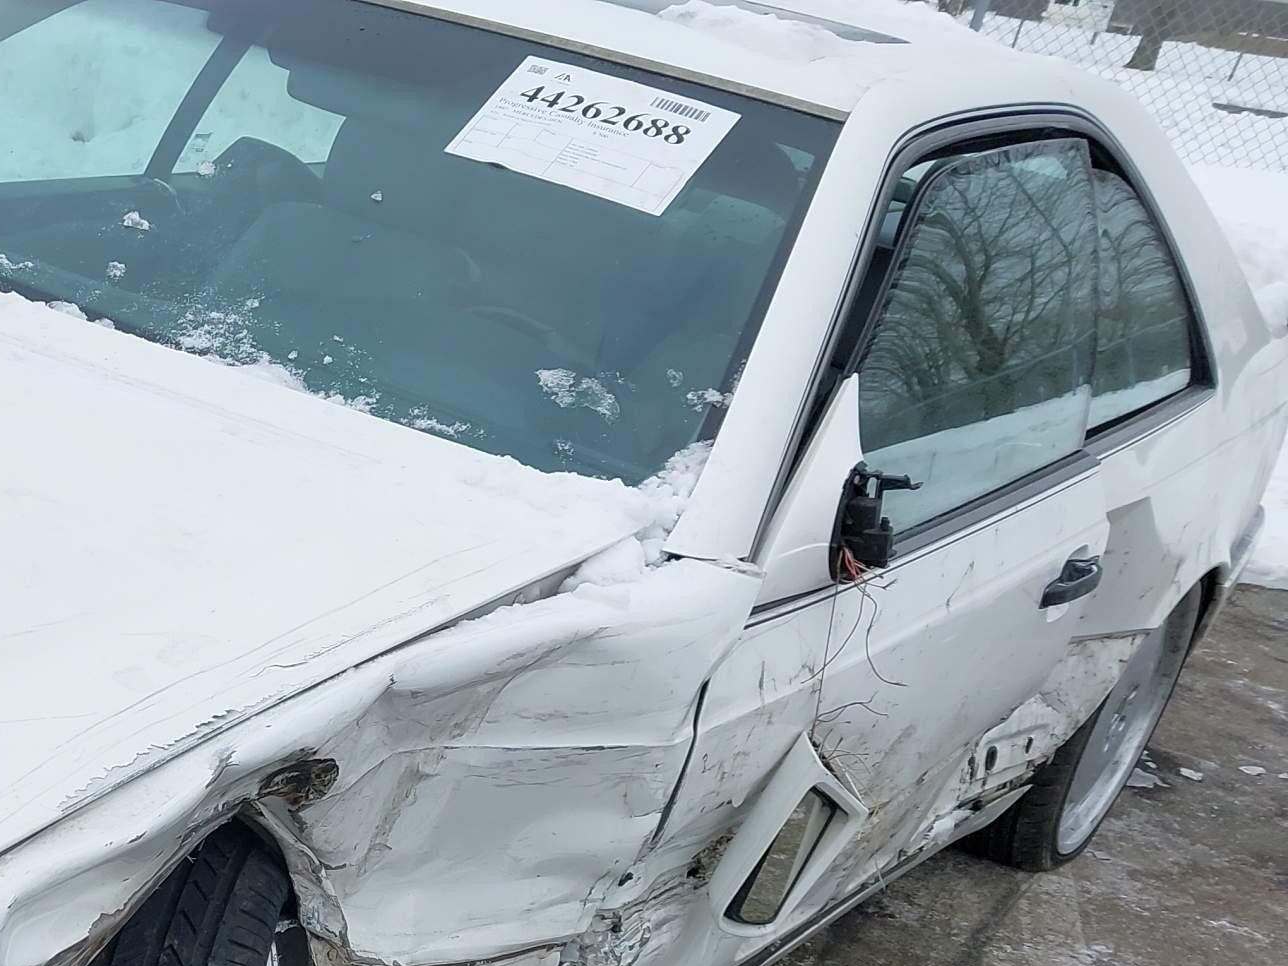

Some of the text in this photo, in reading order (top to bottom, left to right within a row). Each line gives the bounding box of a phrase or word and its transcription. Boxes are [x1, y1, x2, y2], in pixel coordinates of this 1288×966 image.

[499, 97, 548, 115] Progressive
[549, 110, 584, 126] Casualty
[587, 120, 630, 138] Insurance
[520, 85, 692, 146] 44262688
